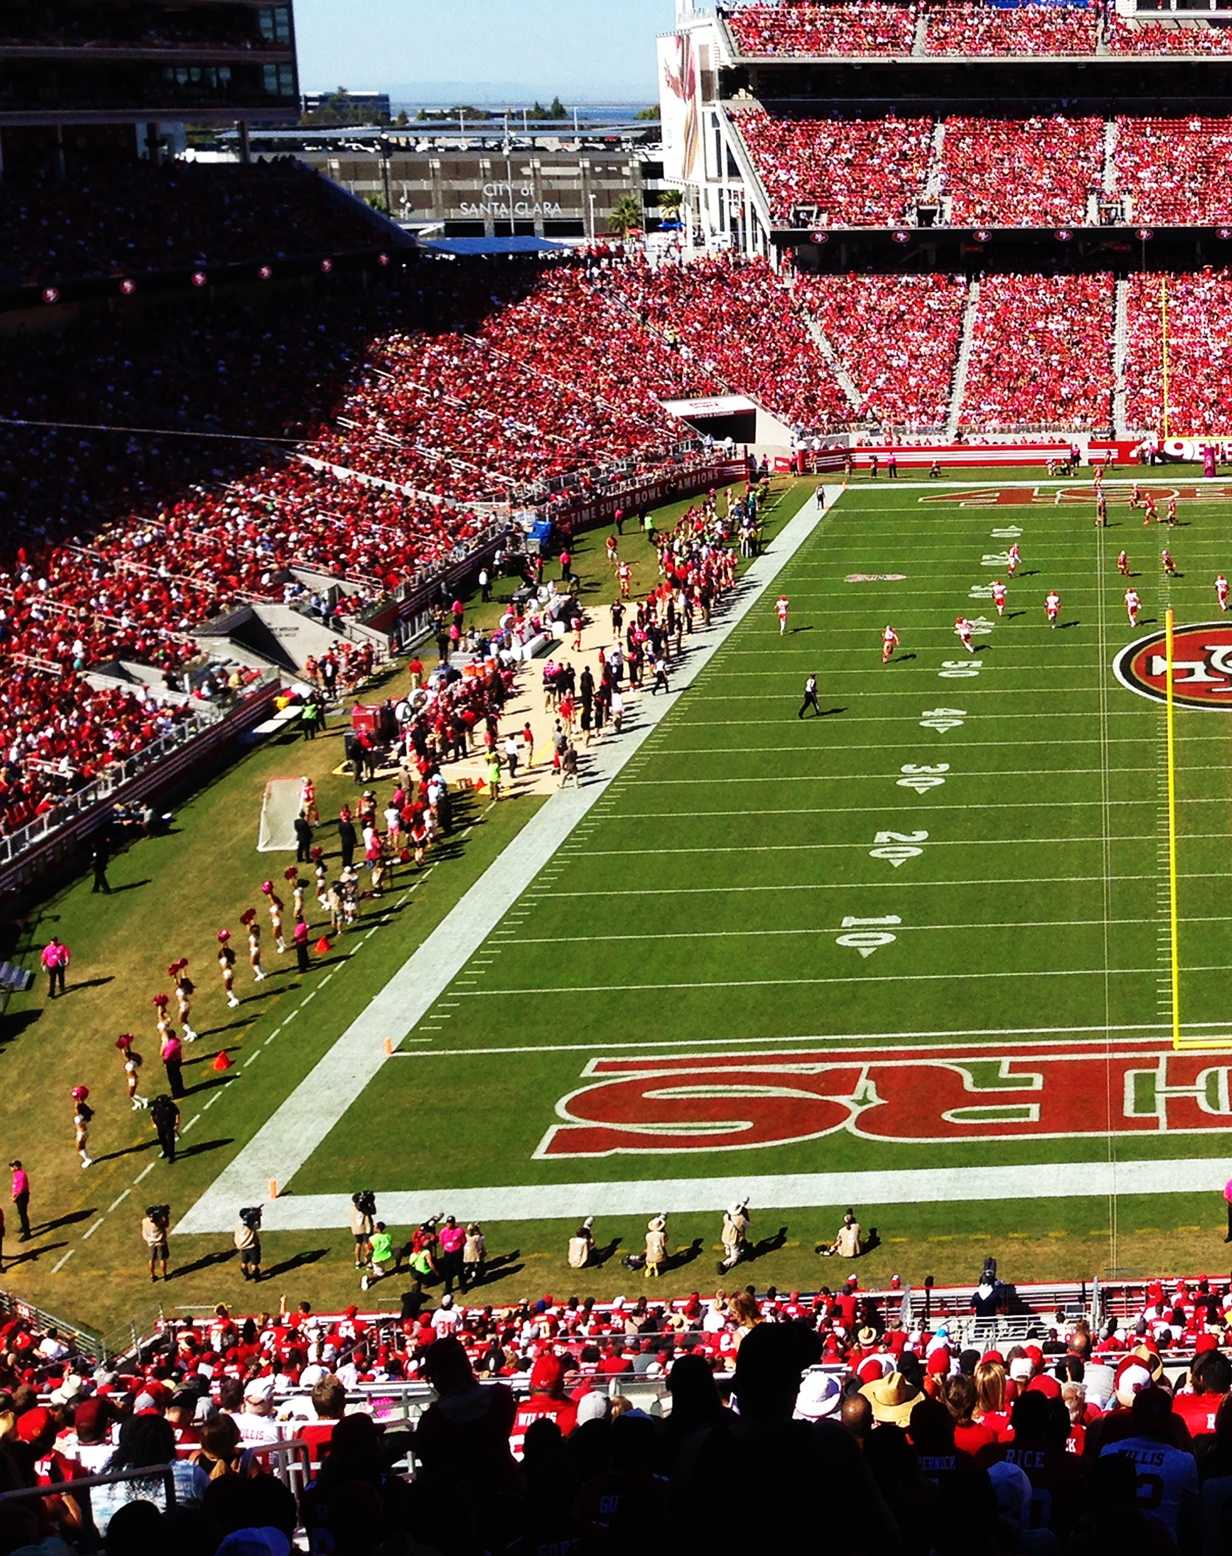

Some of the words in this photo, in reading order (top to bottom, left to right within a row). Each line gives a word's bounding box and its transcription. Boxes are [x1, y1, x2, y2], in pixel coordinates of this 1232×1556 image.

[483, 183, 513, 197] CITY
[520, 182, 535, 197] of
[460, 202, 509, 216] SANTA
[515, 202, 562, 216] CLARA
[570, 507, 598, 526] TIME
[600, 494, 634, 517] SUPER
[635, 483, 663, 505] BOWL
[664, 468, 720, 500] CAMPIONS
[895, 762, 951, 787] 30
[868, 830, 930, 859] 20
[835, 914, 902, 948] 10
[1005, 1448, 1047, 1469] RICE
